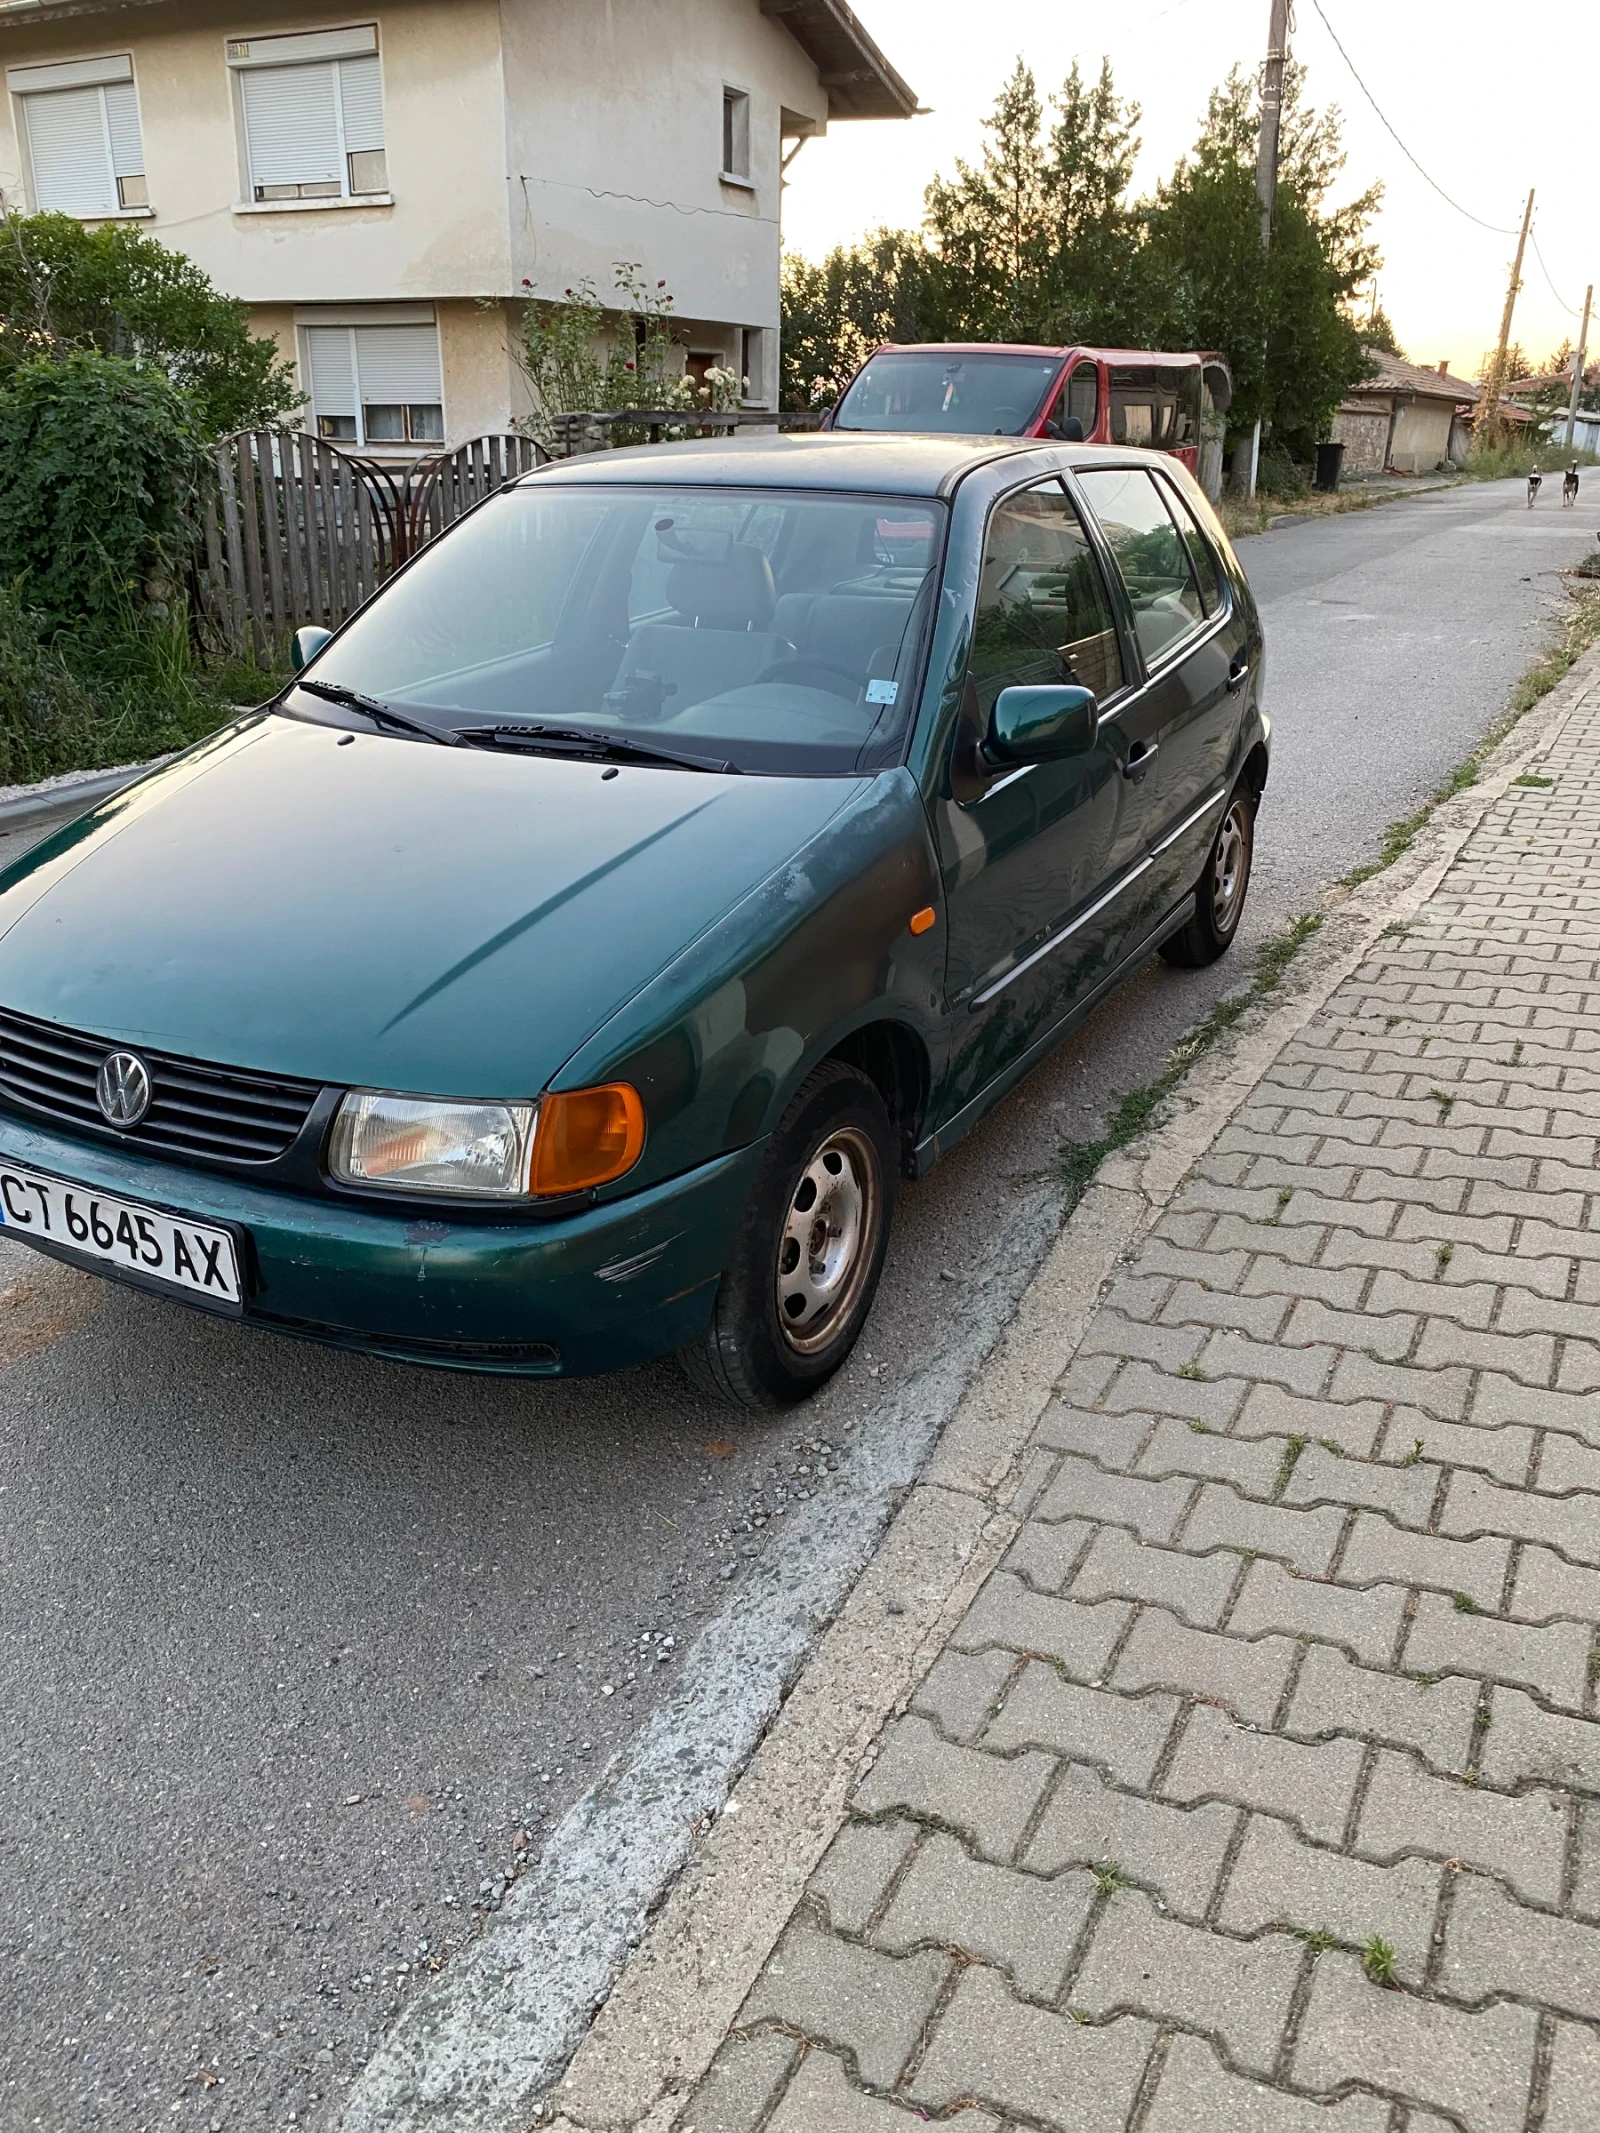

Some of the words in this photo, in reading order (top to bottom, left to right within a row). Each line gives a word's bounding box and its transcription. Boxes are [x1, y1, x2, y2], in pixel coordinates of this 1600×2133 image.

[1, 1174, 51, 1230] CT
[65, 1193, 163, 1268] 6645
[174, 1228, 229, 1292] AX
